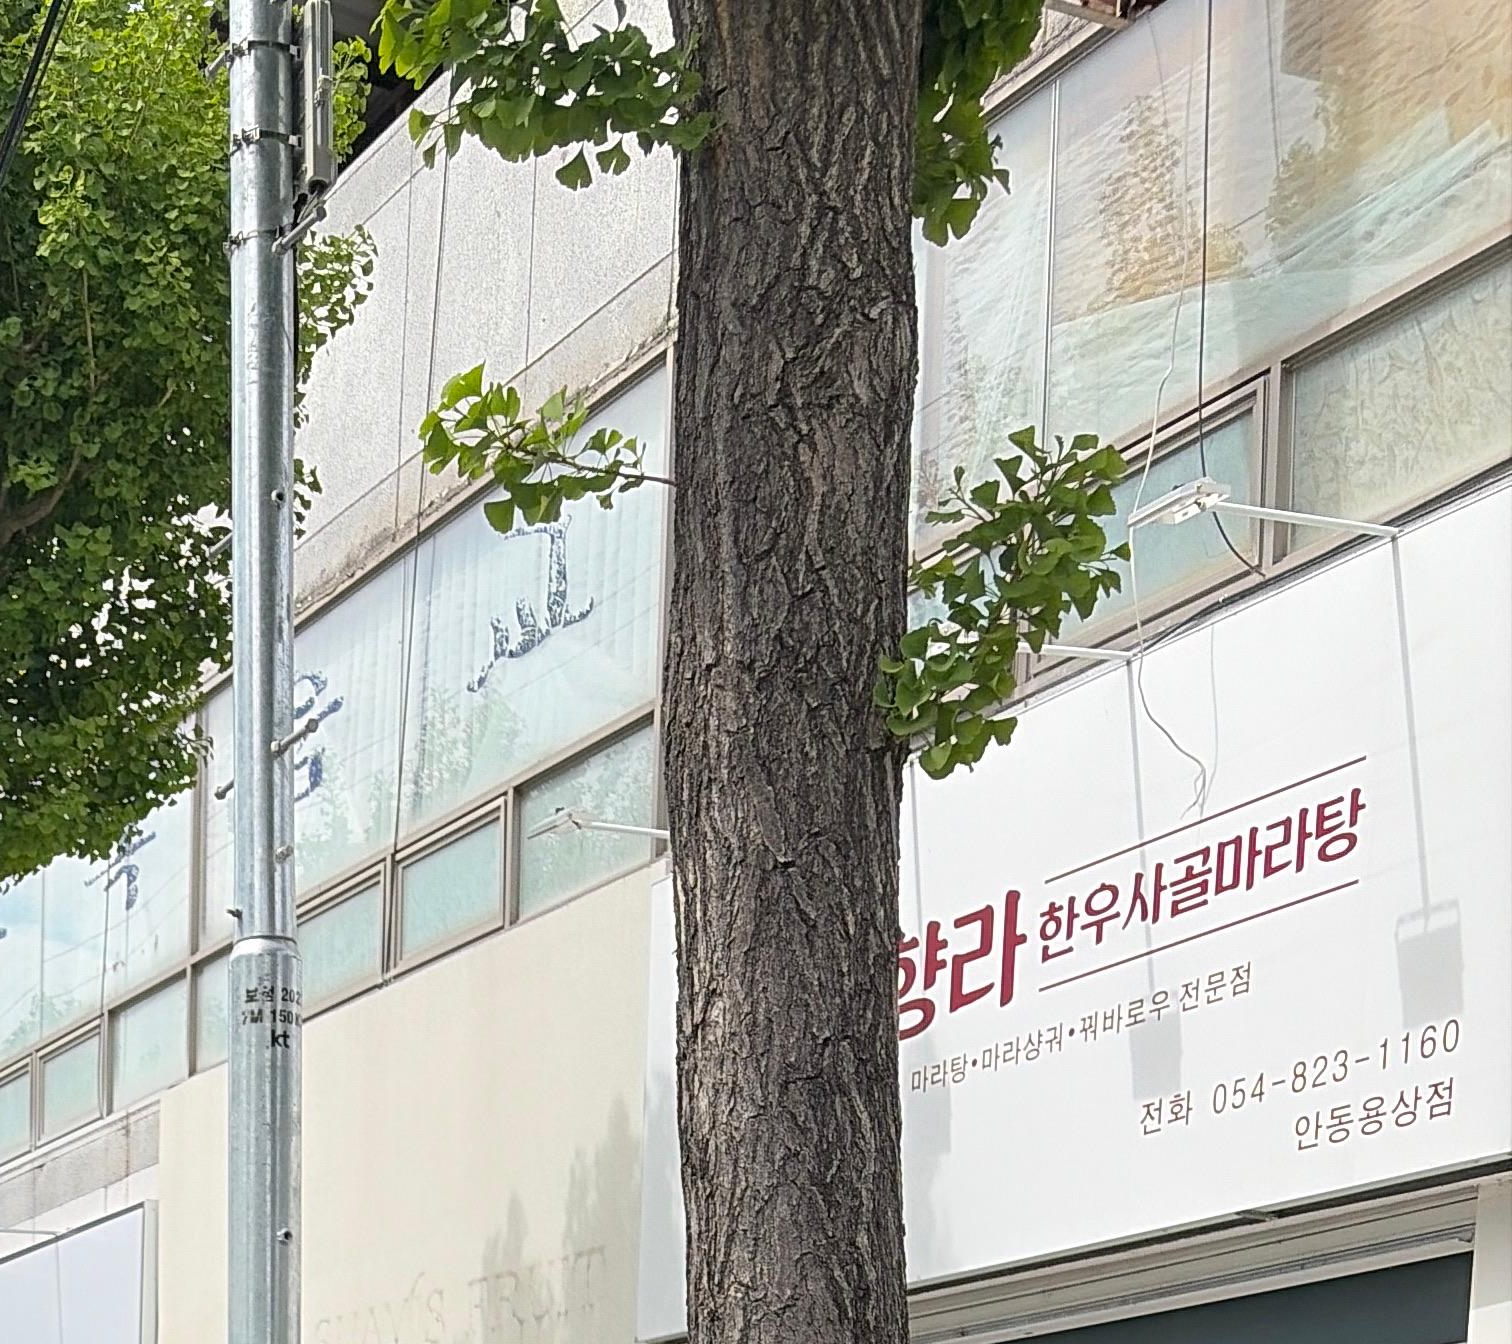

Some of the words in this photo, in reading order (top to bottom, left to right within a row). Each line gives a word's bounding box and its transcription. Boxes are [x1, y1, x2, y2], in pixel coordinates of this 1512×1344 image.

[1040, 788, 1365, 964] 한우사골마라탕
[1179, 961, 1253, 1011] 전문점
[271, 1029, 290, 1049] kt
[1140, 1095, 1193, 1136] 전화
[1212, 1019, 1461, 1116] 054-823-1160
[1295, 1077, 1455, 1151] 안동용상점
